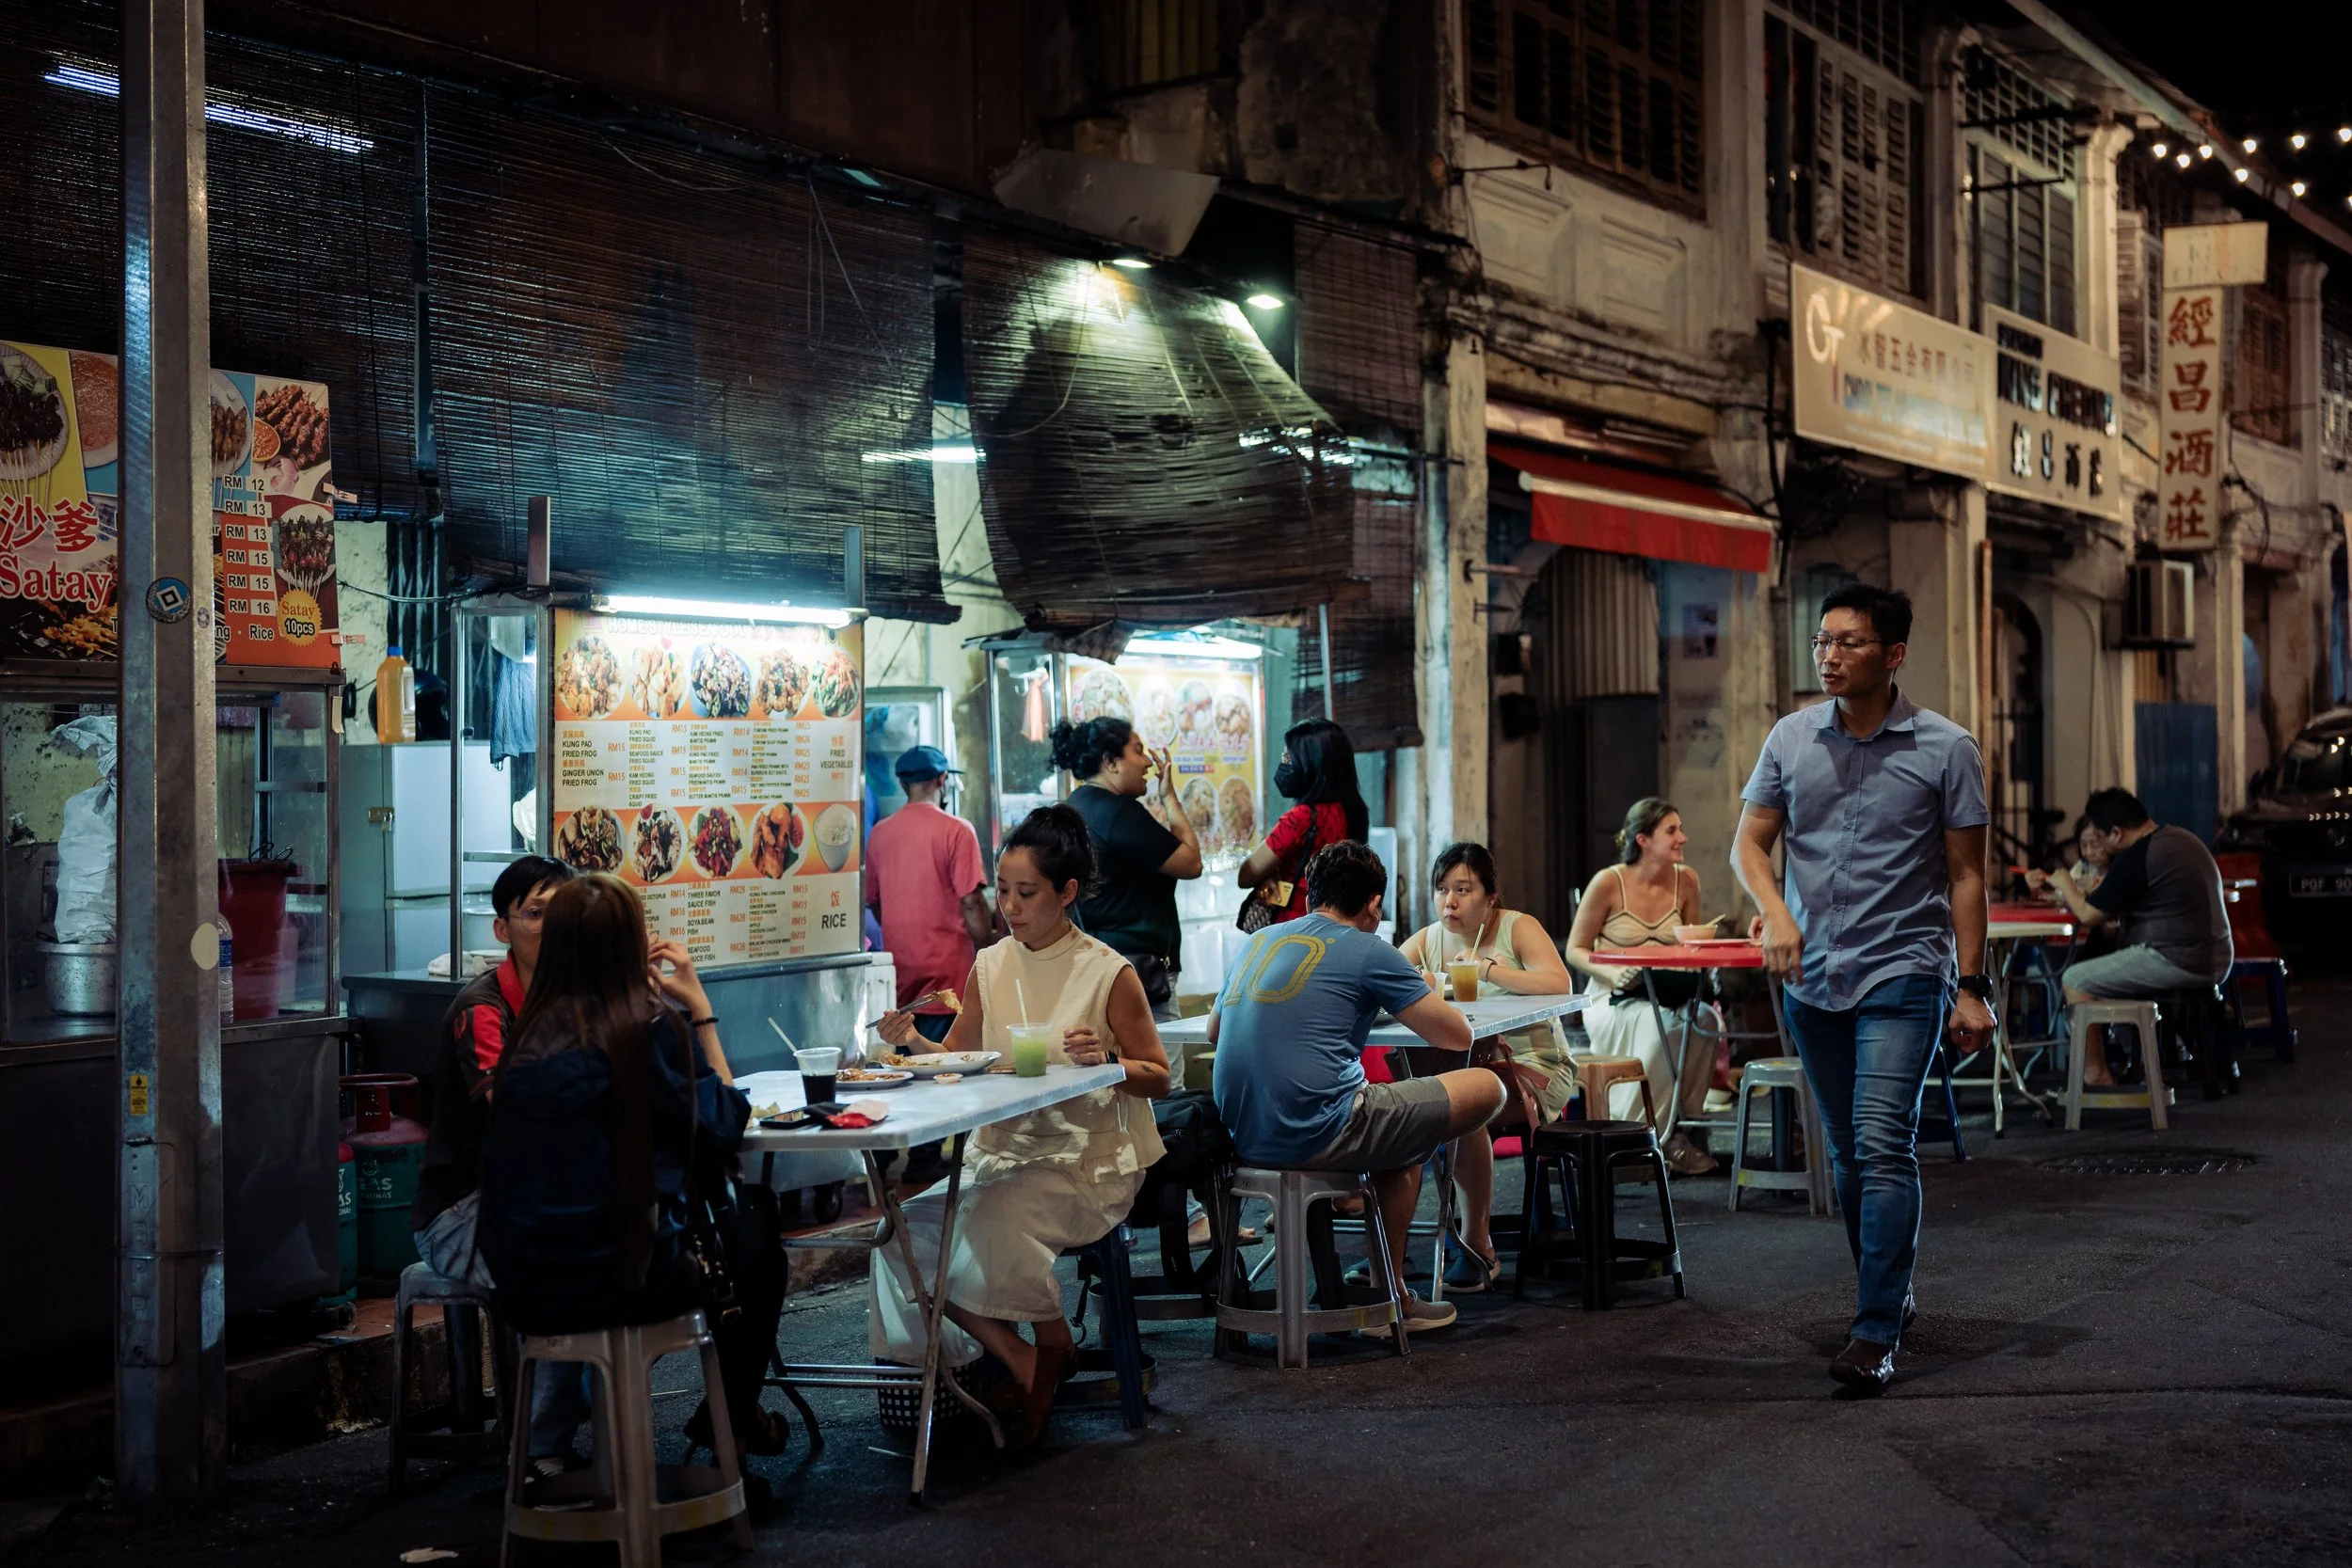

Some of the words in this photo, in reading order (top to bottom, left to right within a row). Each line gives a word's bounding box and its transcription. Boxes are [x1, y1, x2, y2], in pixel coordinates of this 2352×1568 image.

[2167, 295, 2217, 541] 經昌酒莊
[224, 475, 242, 488] RM
[251, 479, 264, 491] 12
[225, 500, 243, 514] RM
[252, 503, 265, 515] 13
[1, 496, 98, 552] 沙爹
[226, 525, 245, 538] RM
[253, 529, 266, 540] 13
[228, 550, 246, 563] RM
[254, 553, 267, 565] 15
[0, 553, 111, 611] Satay
[229, 576, 246, 588] RM
[255, 578, 269, 590] 15
[230, 599, 247, 612] RM
[256, 602, 270, 614] 16
[282, 601, 314, 618] Satay
[249, 626, 274, 641] Rice
[285, 619, 314, 637] 10pcs
[672, 724, 687, 733] RM15
[608, 742, 625, 752] RM15
[671, 746, 687, 754] RM15
[820, 760, 853, 768] VEGETABLES
[608, 772, 625, 782] RM15
[671, 768, 686, 776] RM15
[670, 789, 686, 798] RM15
[670, 890, 686, 898] RM14
[705, 890, 721, 898] FAVOR
[792, 884, 808, 894] RM15
[670, 908, 686, 916] RM16
[821, 913, 847, 929] RICE
[670, 927, 686, 936] RM16
[688, 945, 710, 954] SEAFOOD
[1224, 933, 1326, 1008] 10
[338, 1192, 352, 1207] AS
